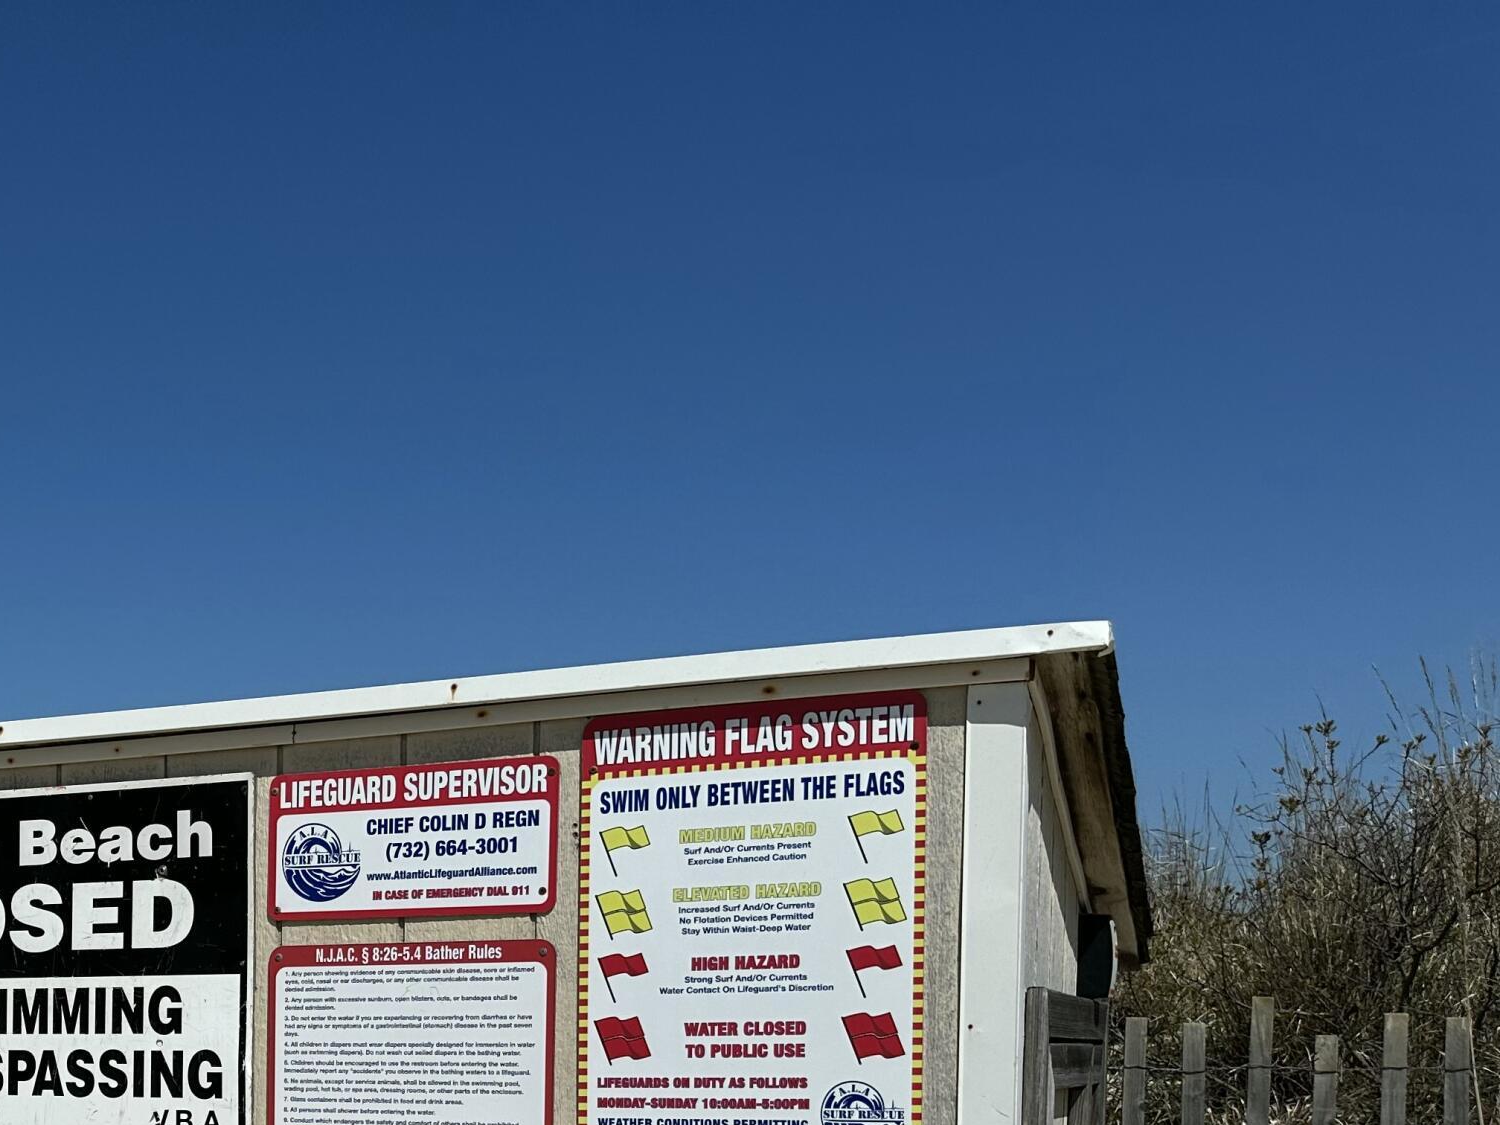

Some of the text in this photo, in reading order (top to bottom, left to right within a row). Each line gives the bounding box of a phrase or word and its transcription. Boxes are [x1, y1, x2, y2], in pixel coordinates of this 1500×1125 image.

[595, 705, 914, 766] WARNING FLAG SYSTEM
[280, 764, 548, 809] LIFEGUARD SUPERVISOR
[600, 770, 905, 815] SWIM ONLY BETWEEN THE FLAGS
[366, 809, 540, 836] CHIEF COLIN D REGN
[19, 809, 213, 867] Beach
[679, 821, 817, 845] MEDIUM HAZARD
[386, 836, 517, 863] (732) 664-3001
[684, 841, 811, 855] Surf And/Or Currents Present
[284, 852, 361, 866] SURF RESCUE
[688, 853, 807, 866] Exercise Enhanced Caution
[366, 866, 537, 881] www.AtlanticLifeguardAlliance.com
[372, 885, 530, 901] IN CASE OF EMERGENCY DIAL 911
[671, 881, 822, 903] ELEVATED HAZARD
[678, 902, 815, 914] Increased Surf And/Or Currents
[679, 912, 814, 925] No Flotation Devices Permitted
[681, 927, 701, 936] Stay
[702, 926, 730, 934] Within
[732, 924, 783, 933] Waist-Deep
[316, 944, 502, 964] N.J.A.C. § 8:26-5.4 Bather Rules
[691, 954, 800, 972] HIGH HAZARD
[684, 973, 808, 985] Strong Surf And/Or Currents
[659, 984, 834, 995] Water Contact On Lifeguard's Discretion
[684, 1021, 807, 1037] WATER CLOSED
[685, 1043, 806, 1059] TO PUBLIC USE
[597, 1077, 808, 1089] LIFEGUARDS ON DUTY AS FOLLOWS
[597, 1097, 810, 1110] MONDAY-SUNDAY 10:00AM-5:00PM
[823, 1109, 905, 1120] SURF RESCUE
